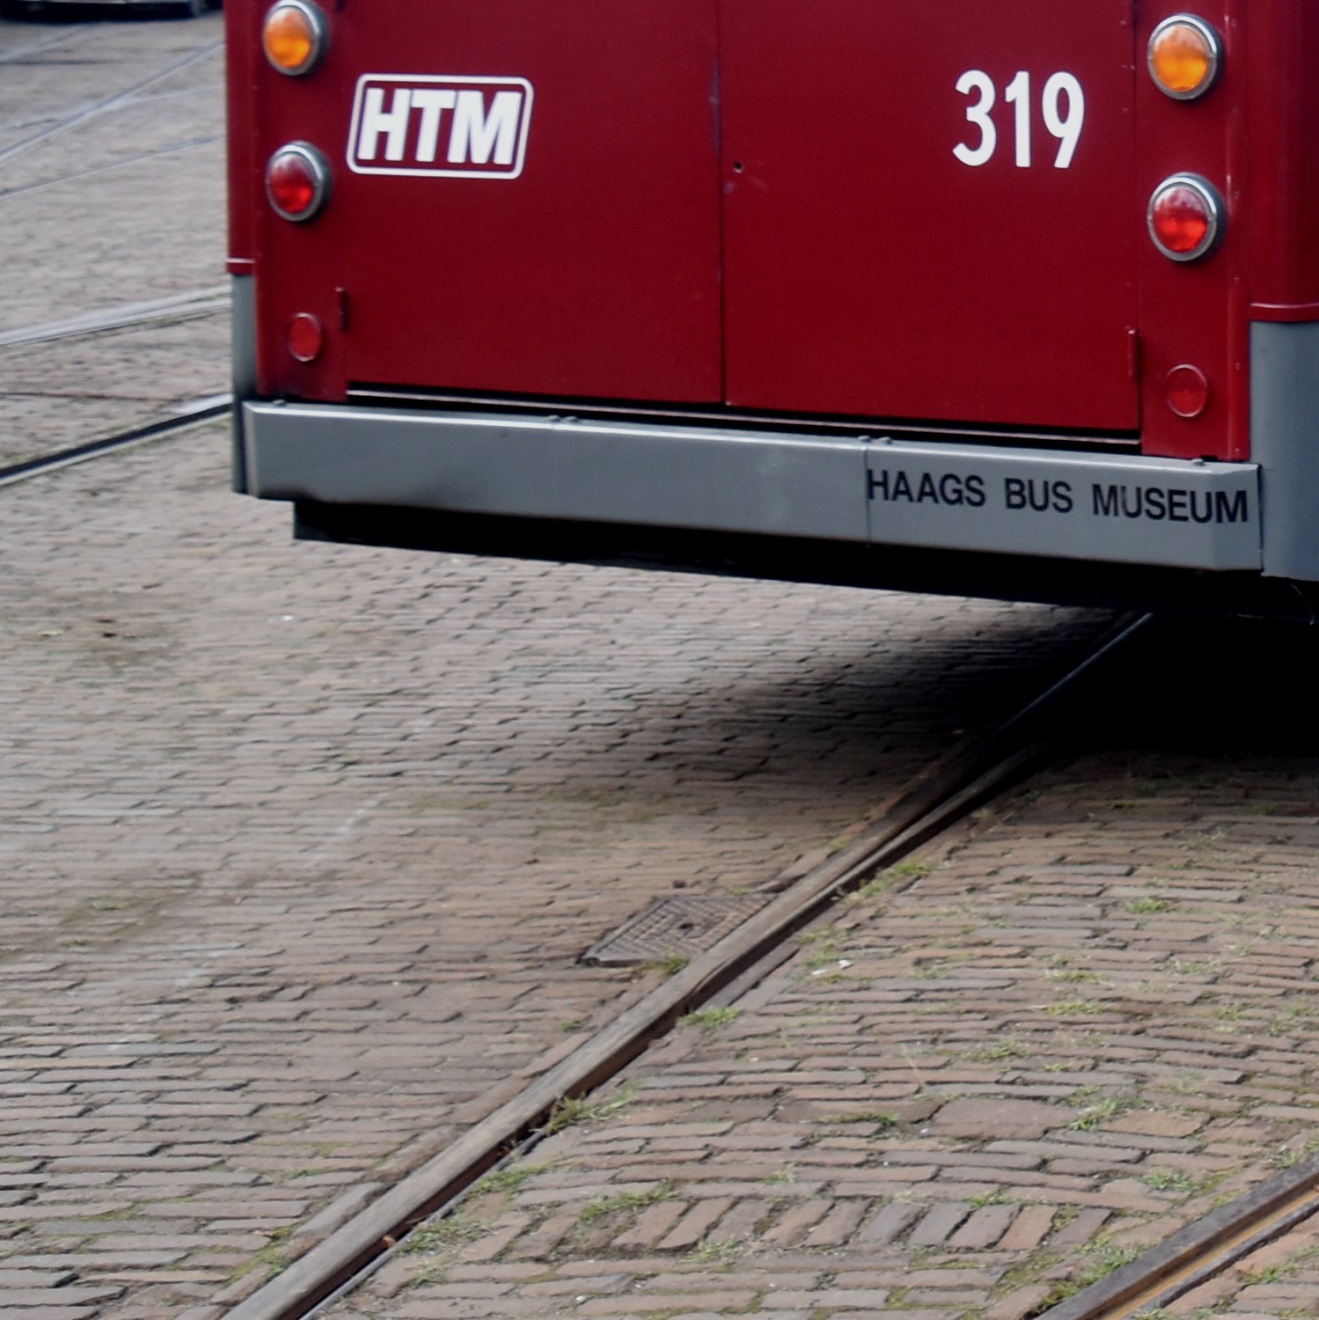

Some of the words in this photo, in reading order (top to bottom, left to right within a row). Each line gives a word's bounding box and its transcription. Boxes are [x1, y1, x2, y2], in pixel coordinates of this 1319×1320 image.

[357, 88, 523, 165] HTM
[952, 68, 1086, 169] 319
[866, 468, 986, 507] HAAGS
[1004, 477, 1074, 514] BUS
[1092, 483, 1249, 524] MUSEUM
